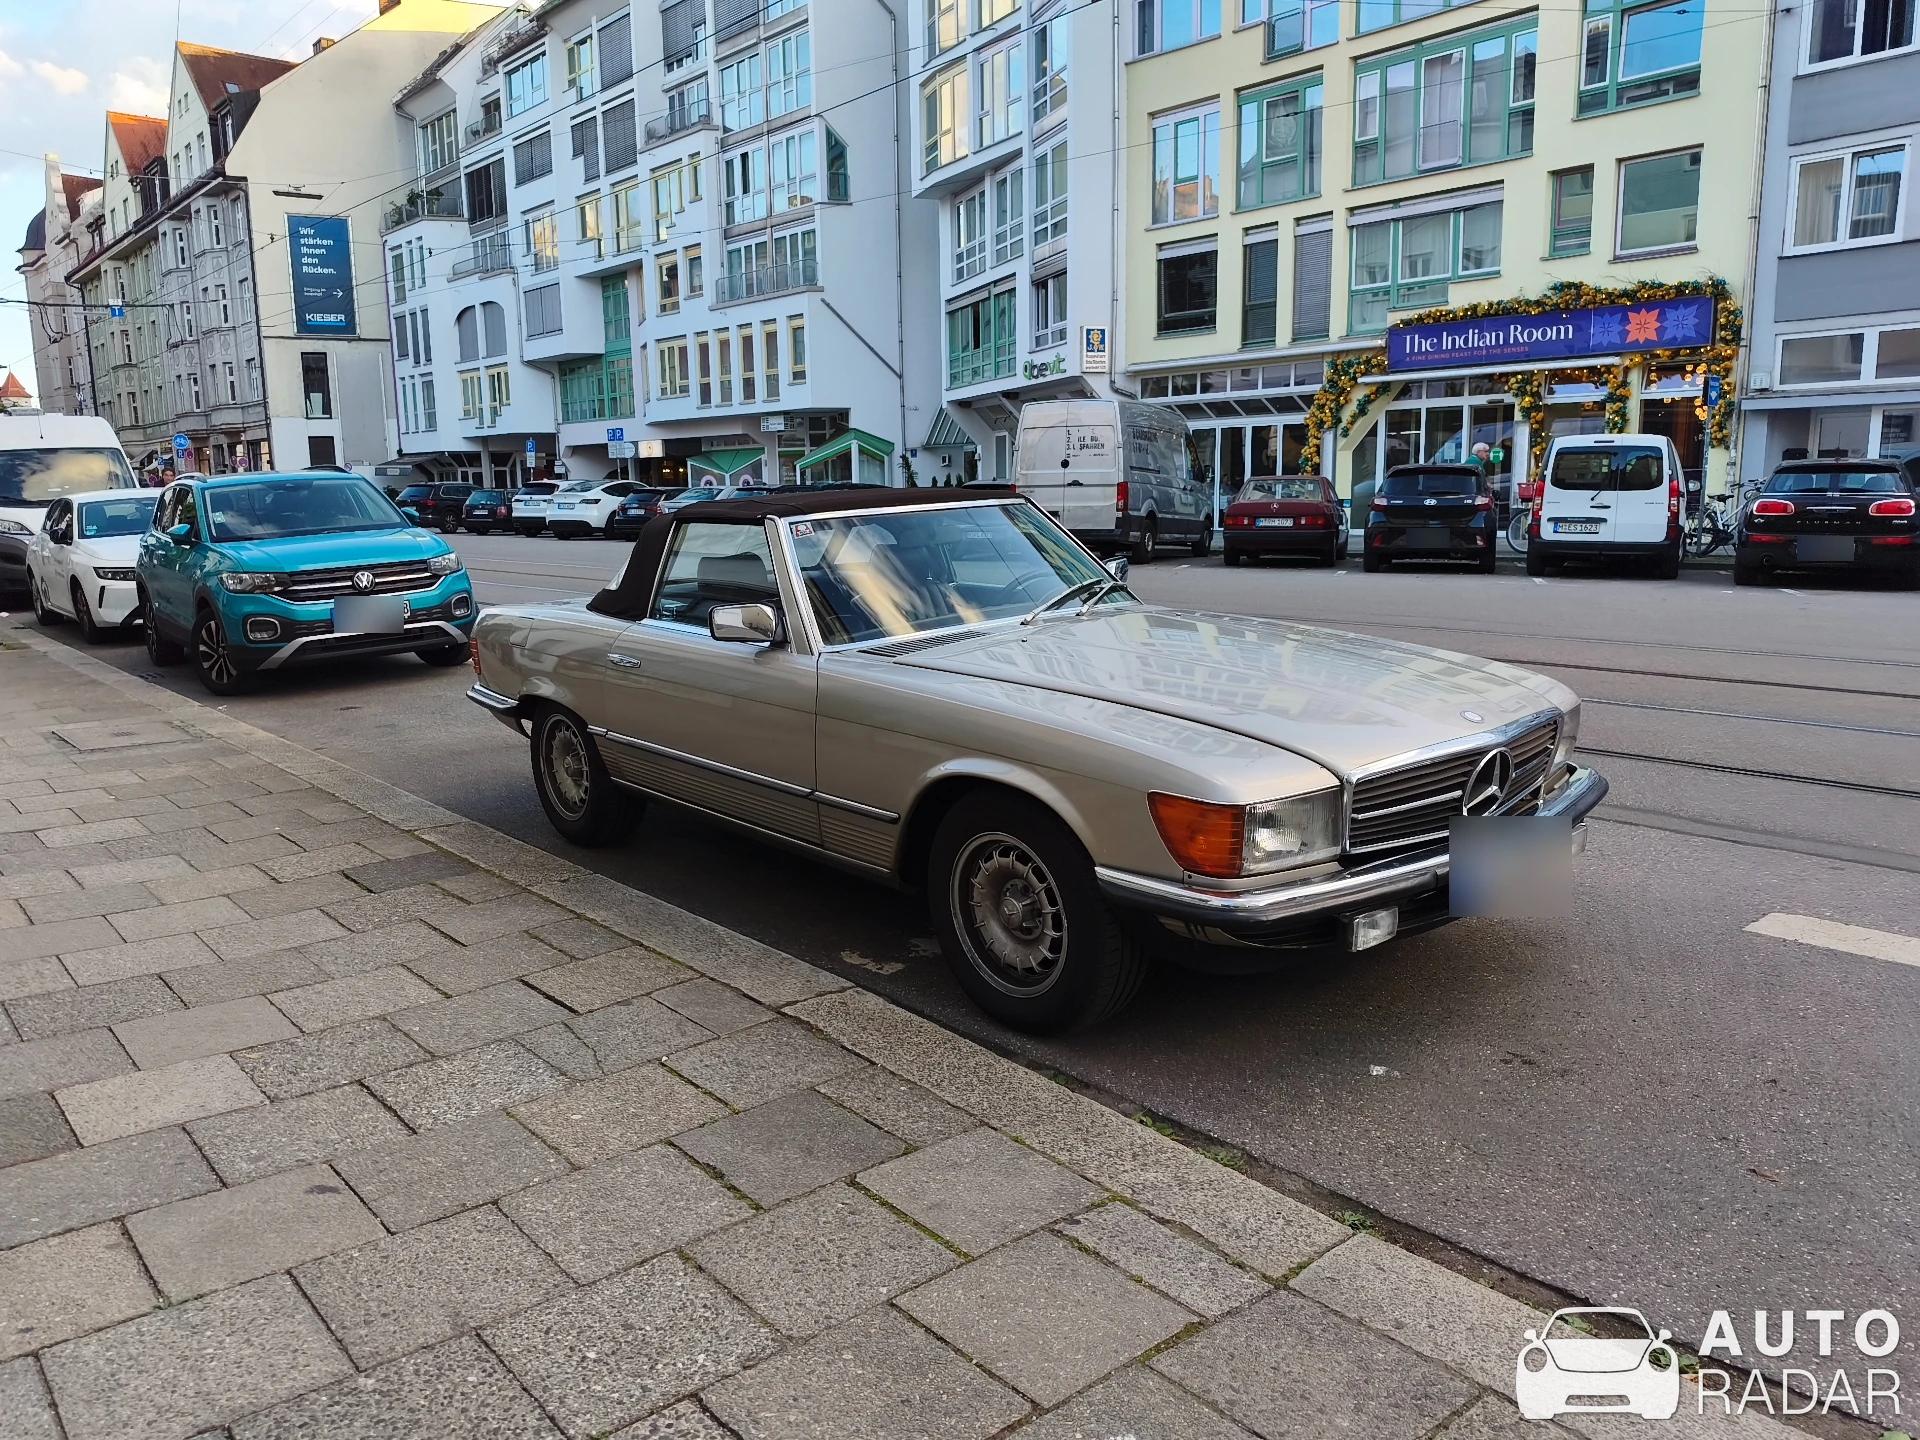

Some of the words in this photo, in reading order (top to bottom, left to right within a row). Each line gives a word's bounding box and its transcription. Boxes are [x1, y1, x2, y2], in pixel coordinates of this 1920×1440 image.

[299, 227, 315, 235] Wir
[300, 237, 333, 246] stärken
[300, 246, 326, 255] Ihnen
[302, 256, 318, 264] den
[302, 265, 337, 275] Rücken.
[306, 313, 345, 322] KIESER
[1403, 334, 1438, 354] The
[1442, 328, 1503, 350] Indian
[1509, 324, 1573, 344] Room
[1503, 346, 1529, 354] SENSES
[1579, 524, 1598, 532] 1623
